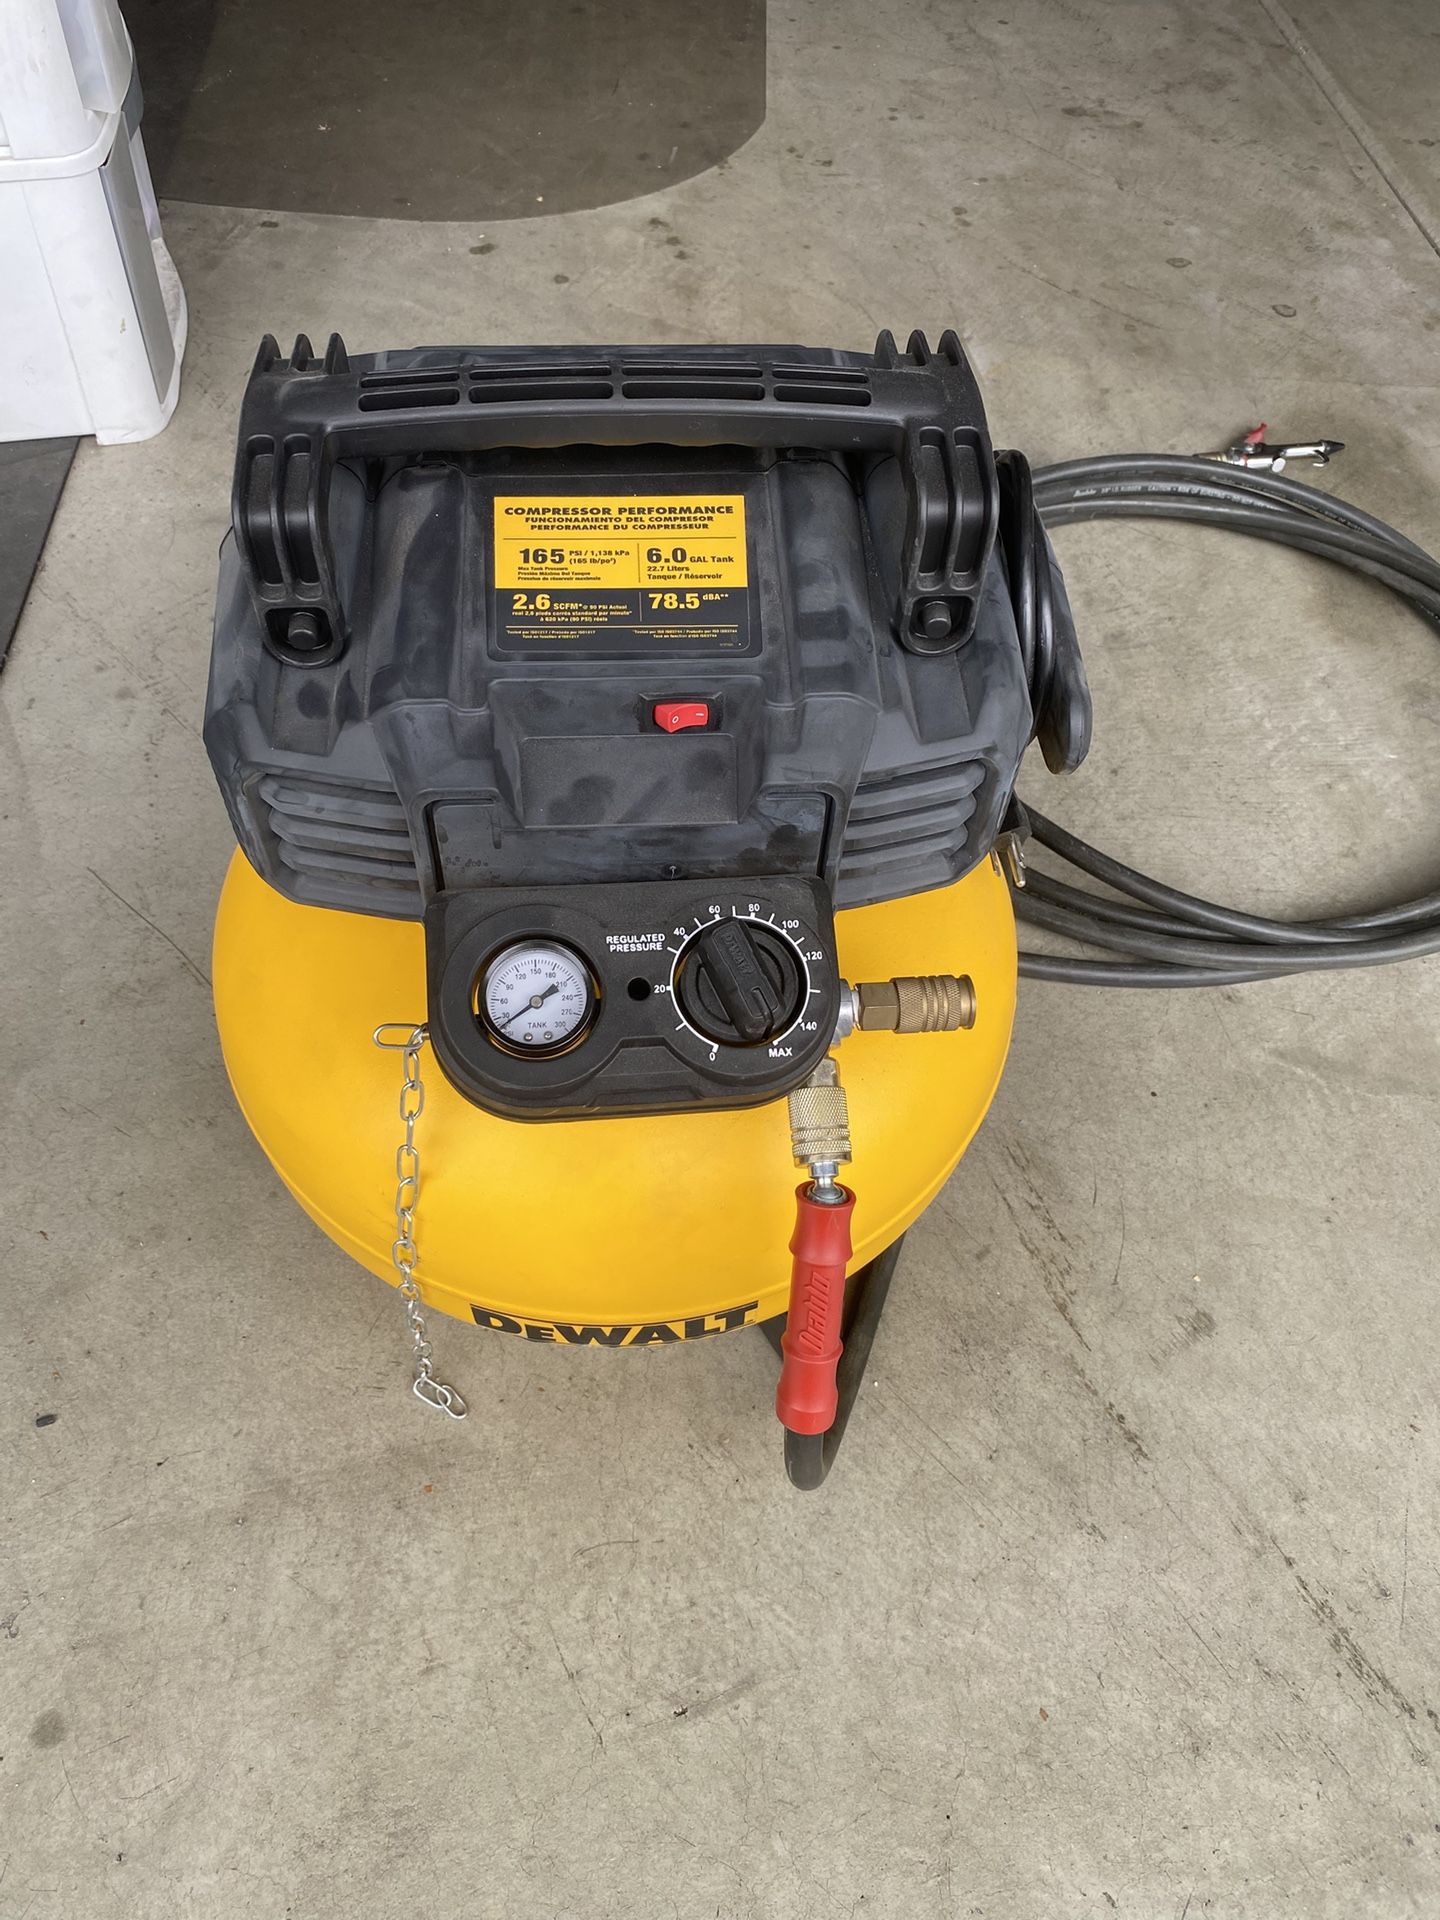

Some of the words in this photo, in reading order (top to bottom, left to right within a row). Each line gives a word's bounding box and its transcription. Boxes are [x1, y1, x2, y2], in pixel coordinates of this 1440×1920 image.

[504, 507, 612, 516] COMPRESSOR
[618, 505, 734, 515] PERFORMANCE
[519, 548, 565, 565] 165
[646, 547, 687, 564] 6.0
[711, 555, 735, 563] Tank
[512, 593, 551, 610] 2.6
[648, 593, 700, 610] 78.5
[708, 905, 721, 914] 60
[748, 903, 760, 912] 80
[782, 920, 799, 929] 100
[673, 927, 686, 936] 40
[606, 933, 666, 944] REGULATED
[609, 942, 663, 953] PRESSURE
[806, 951, 823, 960] 120
[654, 984, 665, 993] 20
[801, 1021, 817, 1031] 140
[709, 1052, 716, 1061] 0
[768, 1047, 793, 1058] MAX
[470, 1300, 759, 1347] DEWALT
